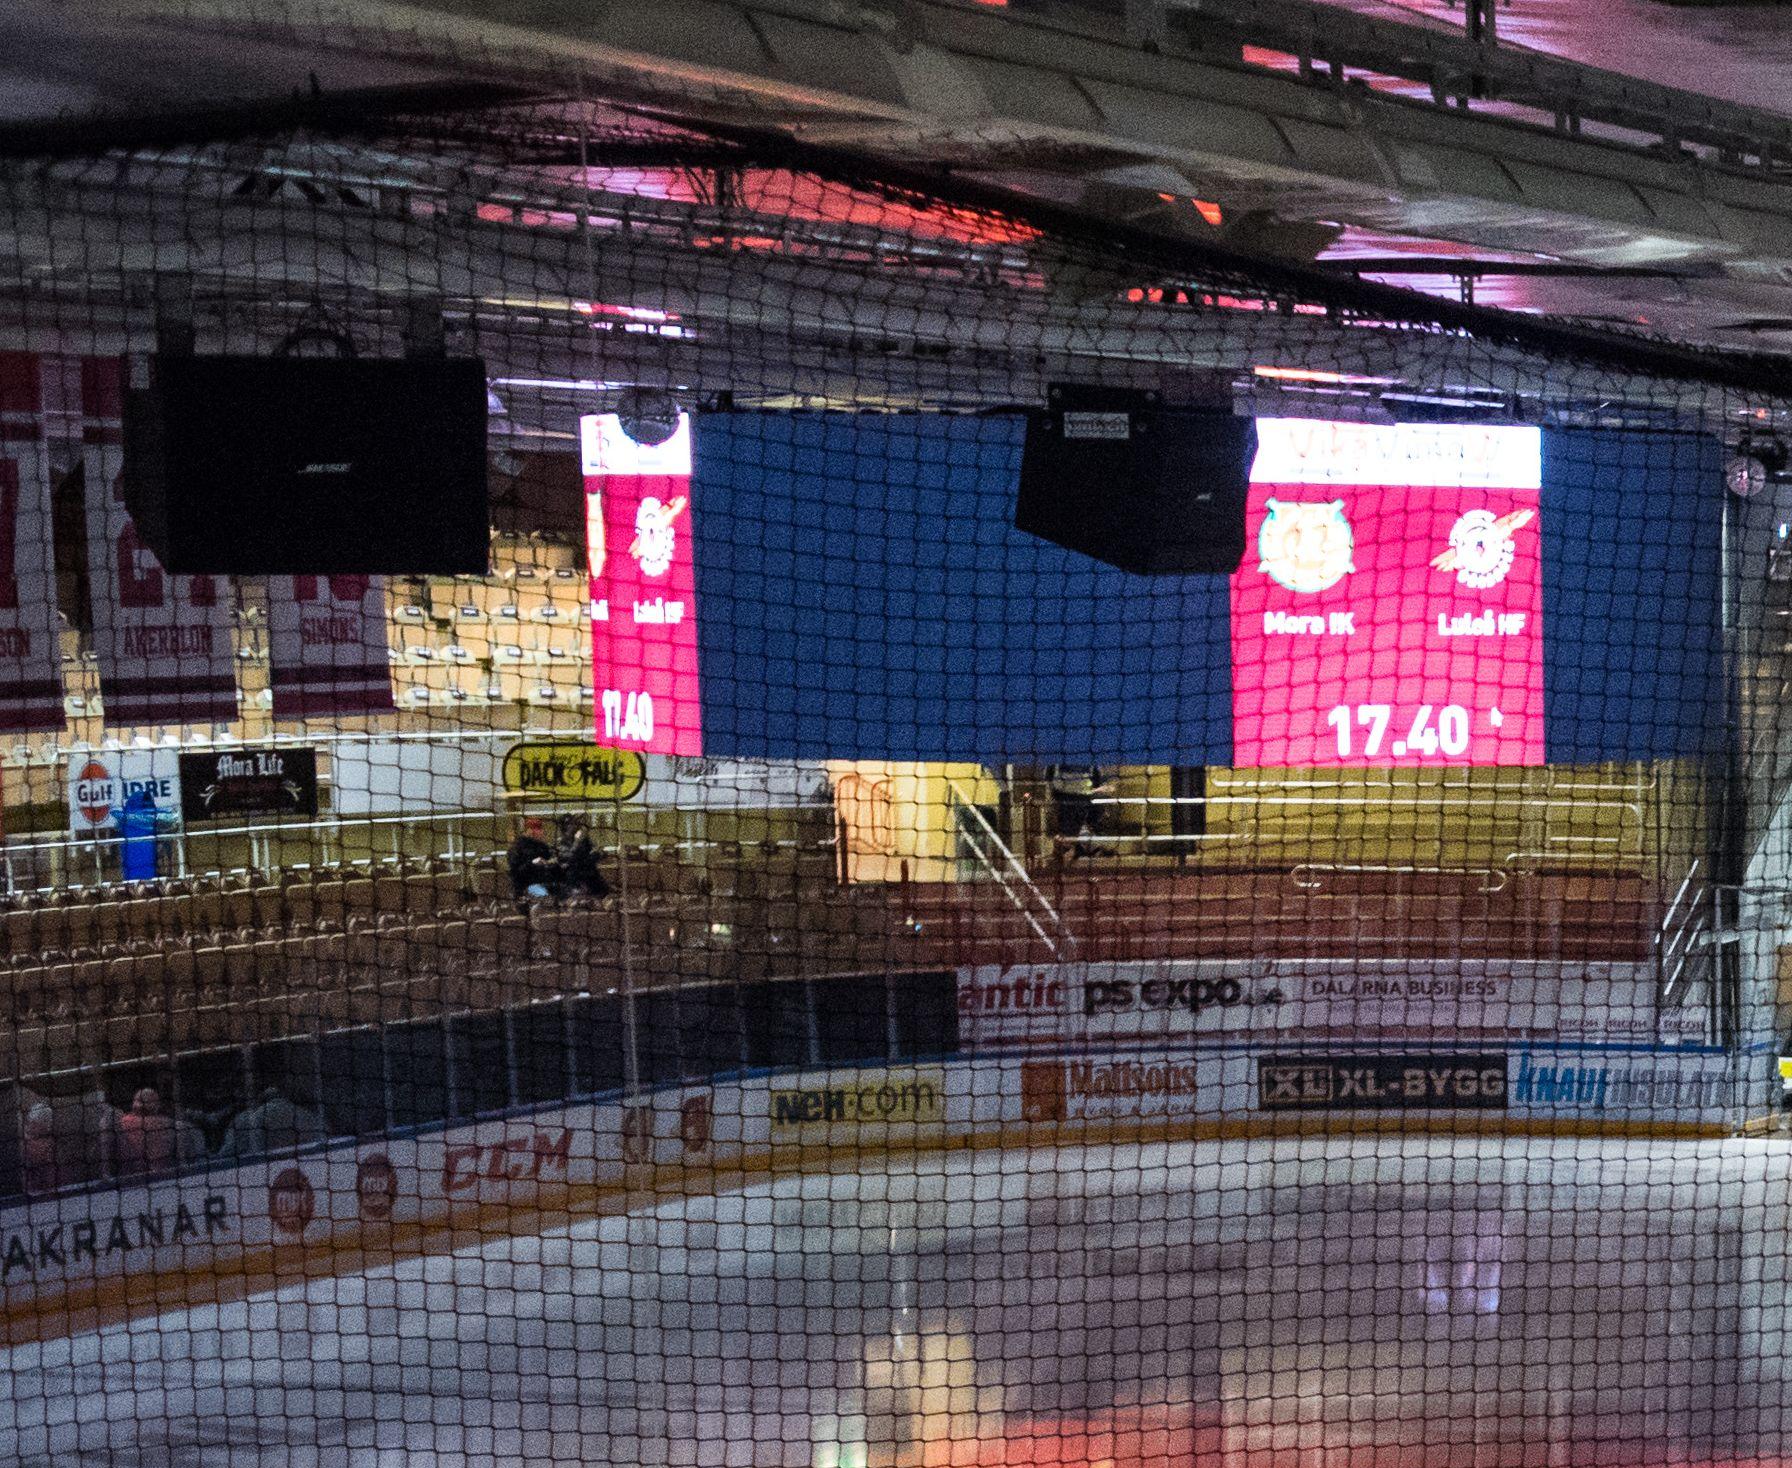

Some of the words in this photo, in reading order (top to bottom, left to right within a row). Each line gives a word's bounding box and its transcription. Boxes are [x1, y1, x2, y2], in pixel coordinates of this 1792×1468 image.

[1329, 612, 1356, 635] IK
[1327, 705, 1469, 757] 17.40
[217, 754, 254, 780] Mora
[258, 752, 285, 777] Life
[77, 779, 113, 803] Gulf
[1311, 981, 1404, 997] DALARNA
[1408, 981, 1498, 997] BUSINESS
[1340, 1068, 1505, 1098] XL-BYGG
[1515, 1050, 1608, 1108] KNAUF
[441, 1127, 573, 1192] CCM
[2, 1195, 230, 1276] AKRANAR
